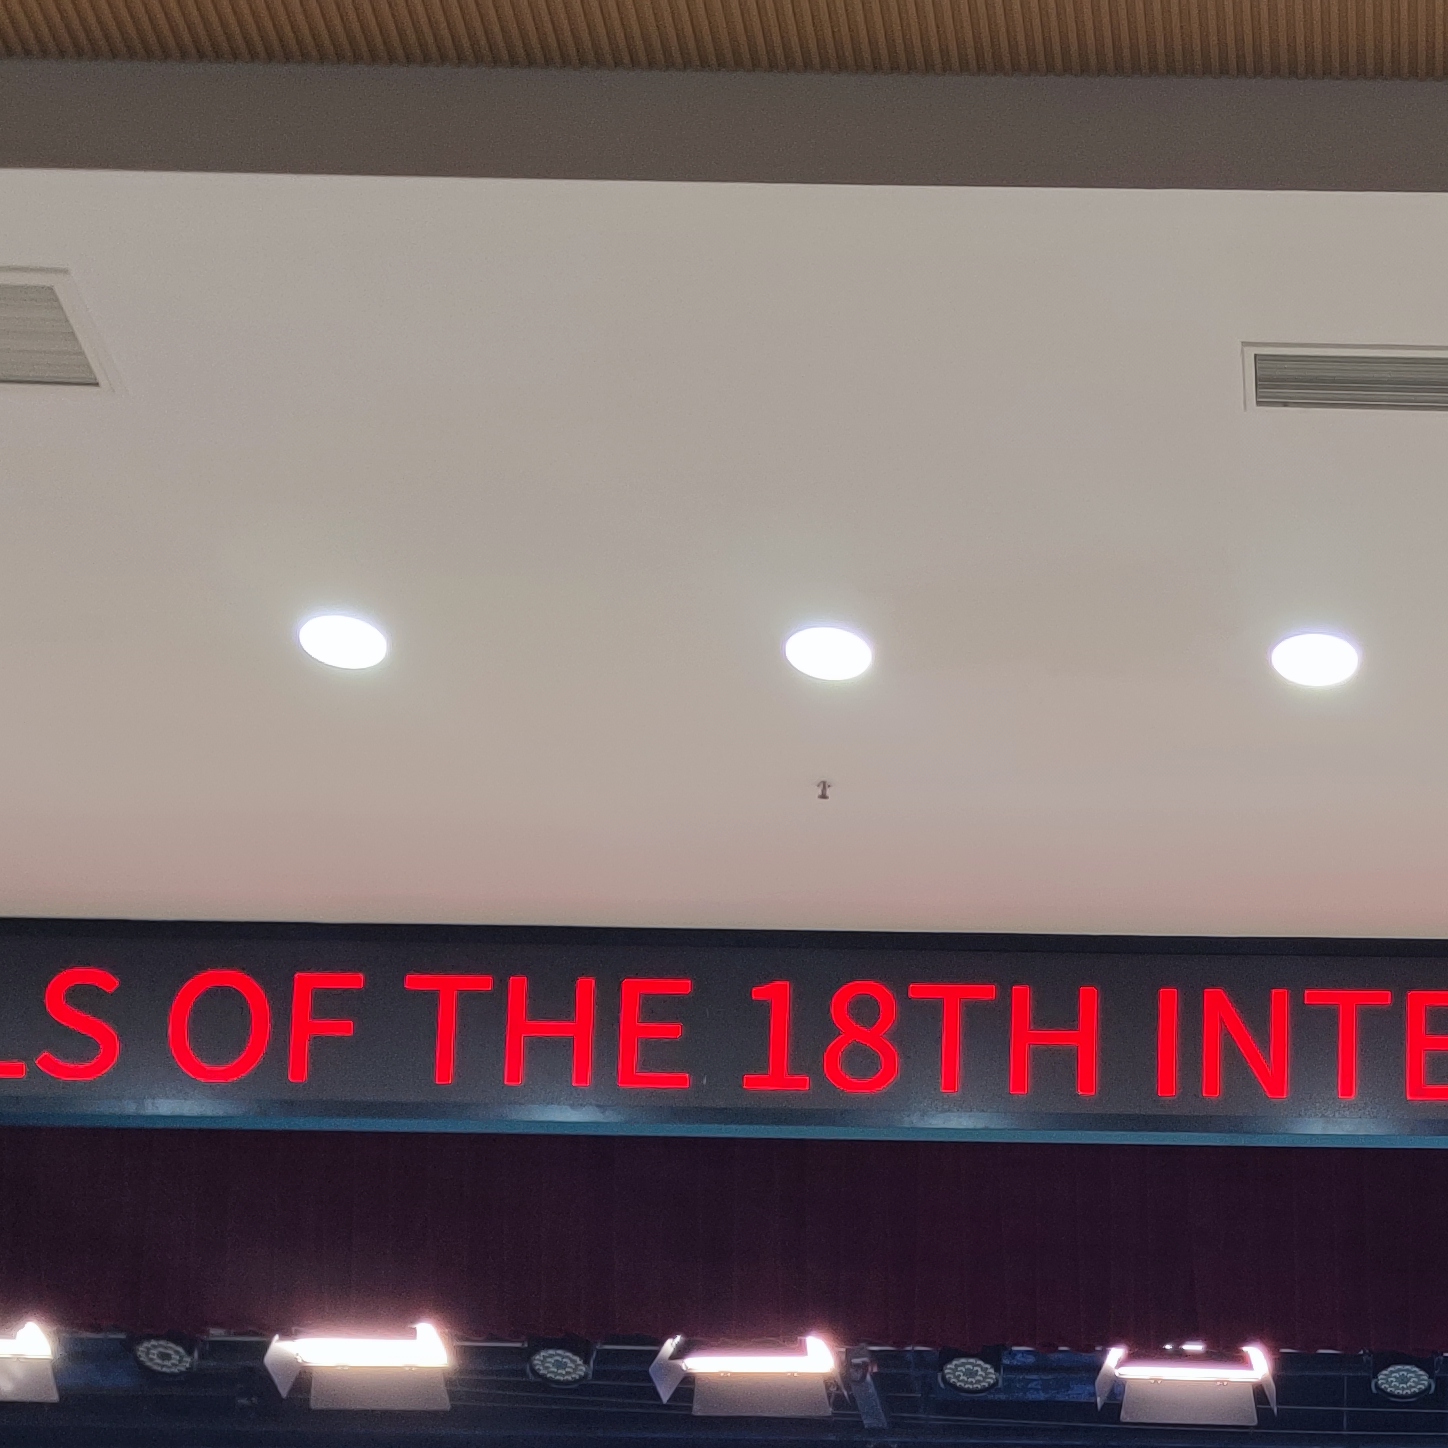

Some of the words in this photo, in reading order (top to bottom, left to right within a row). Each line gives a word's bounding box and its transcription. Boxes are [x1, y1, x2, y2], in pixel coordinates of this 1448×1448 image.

[166, 968, 366, 1084] OF
[403, 973, 694, 1090] THE
[742, 979, 1100, 1098] 18TH
